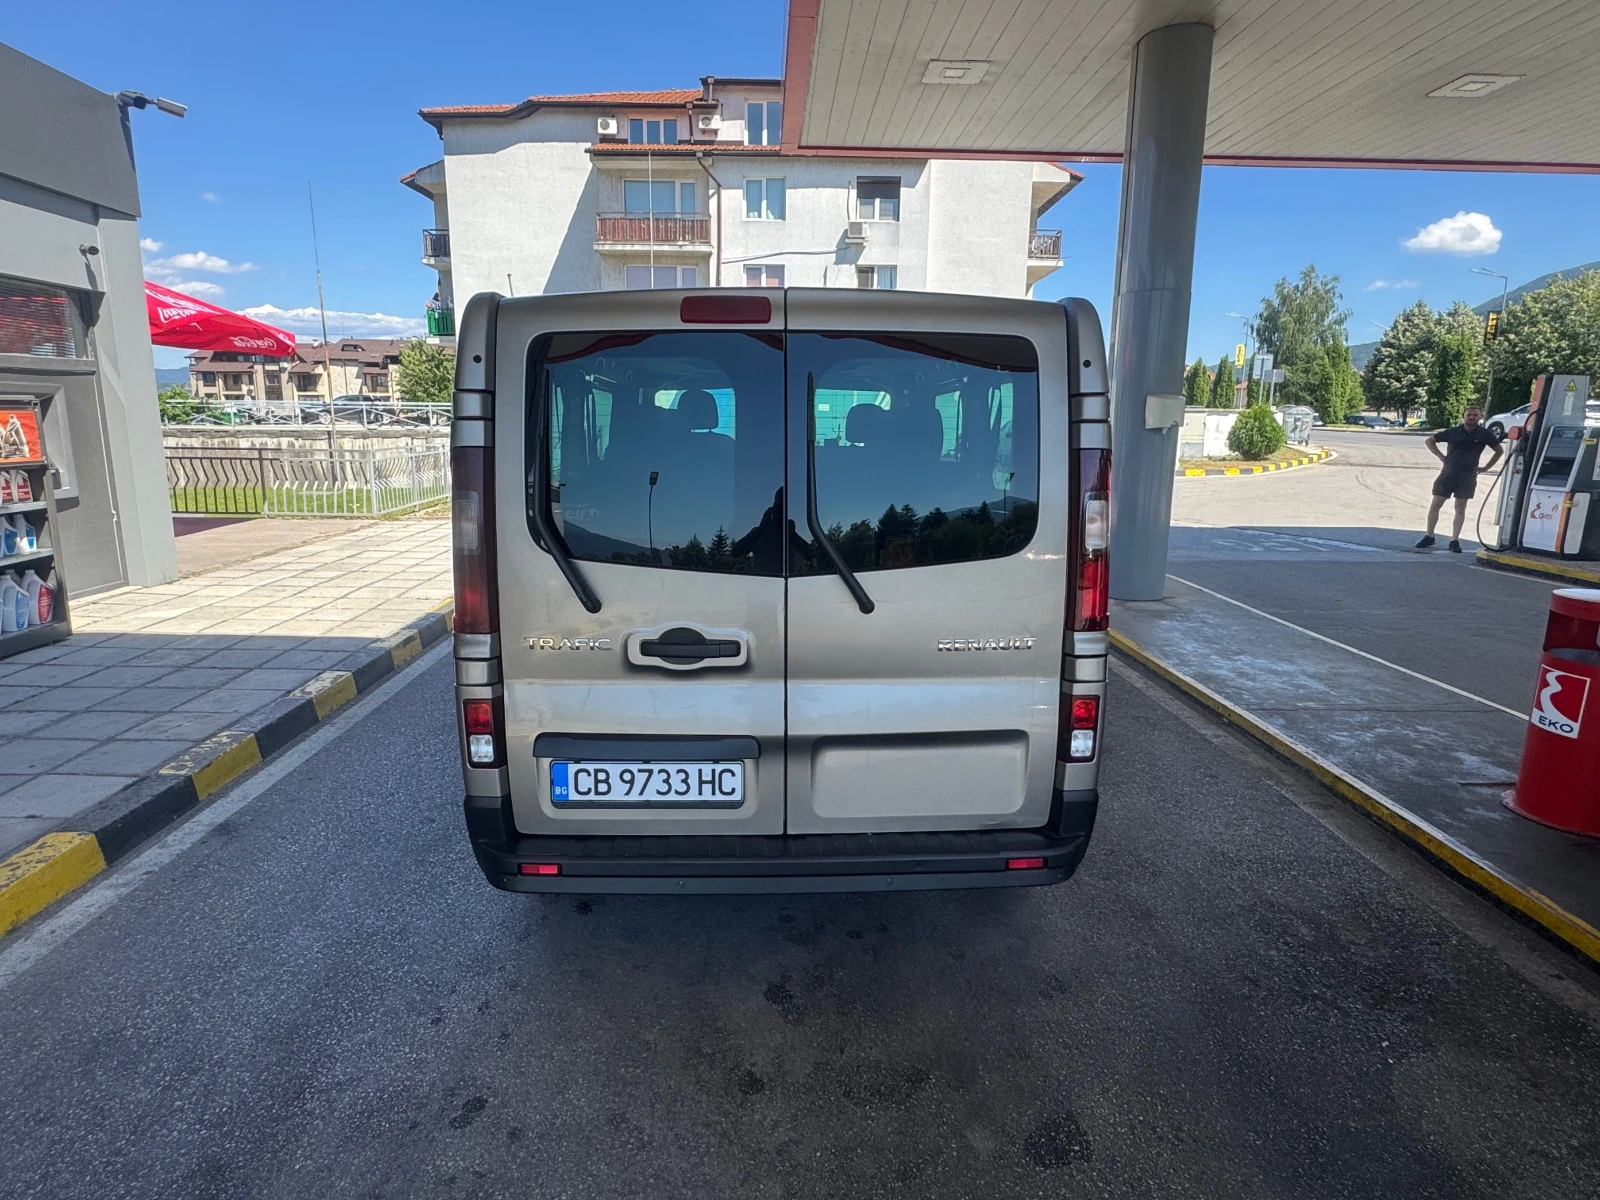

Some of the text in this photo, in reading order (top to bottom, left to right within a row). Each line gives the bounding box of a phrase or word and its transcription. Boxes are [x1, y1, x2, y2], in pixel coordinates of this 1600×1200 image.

[523, 636, 613, 651] TRAFIC
[937, 637, 1037, 651] RENAULT
[1538, 715, 1574, 733] EKO
[573, 768, 736, 796] CB 9733 HC
[555, 786, 568, 795] BG
